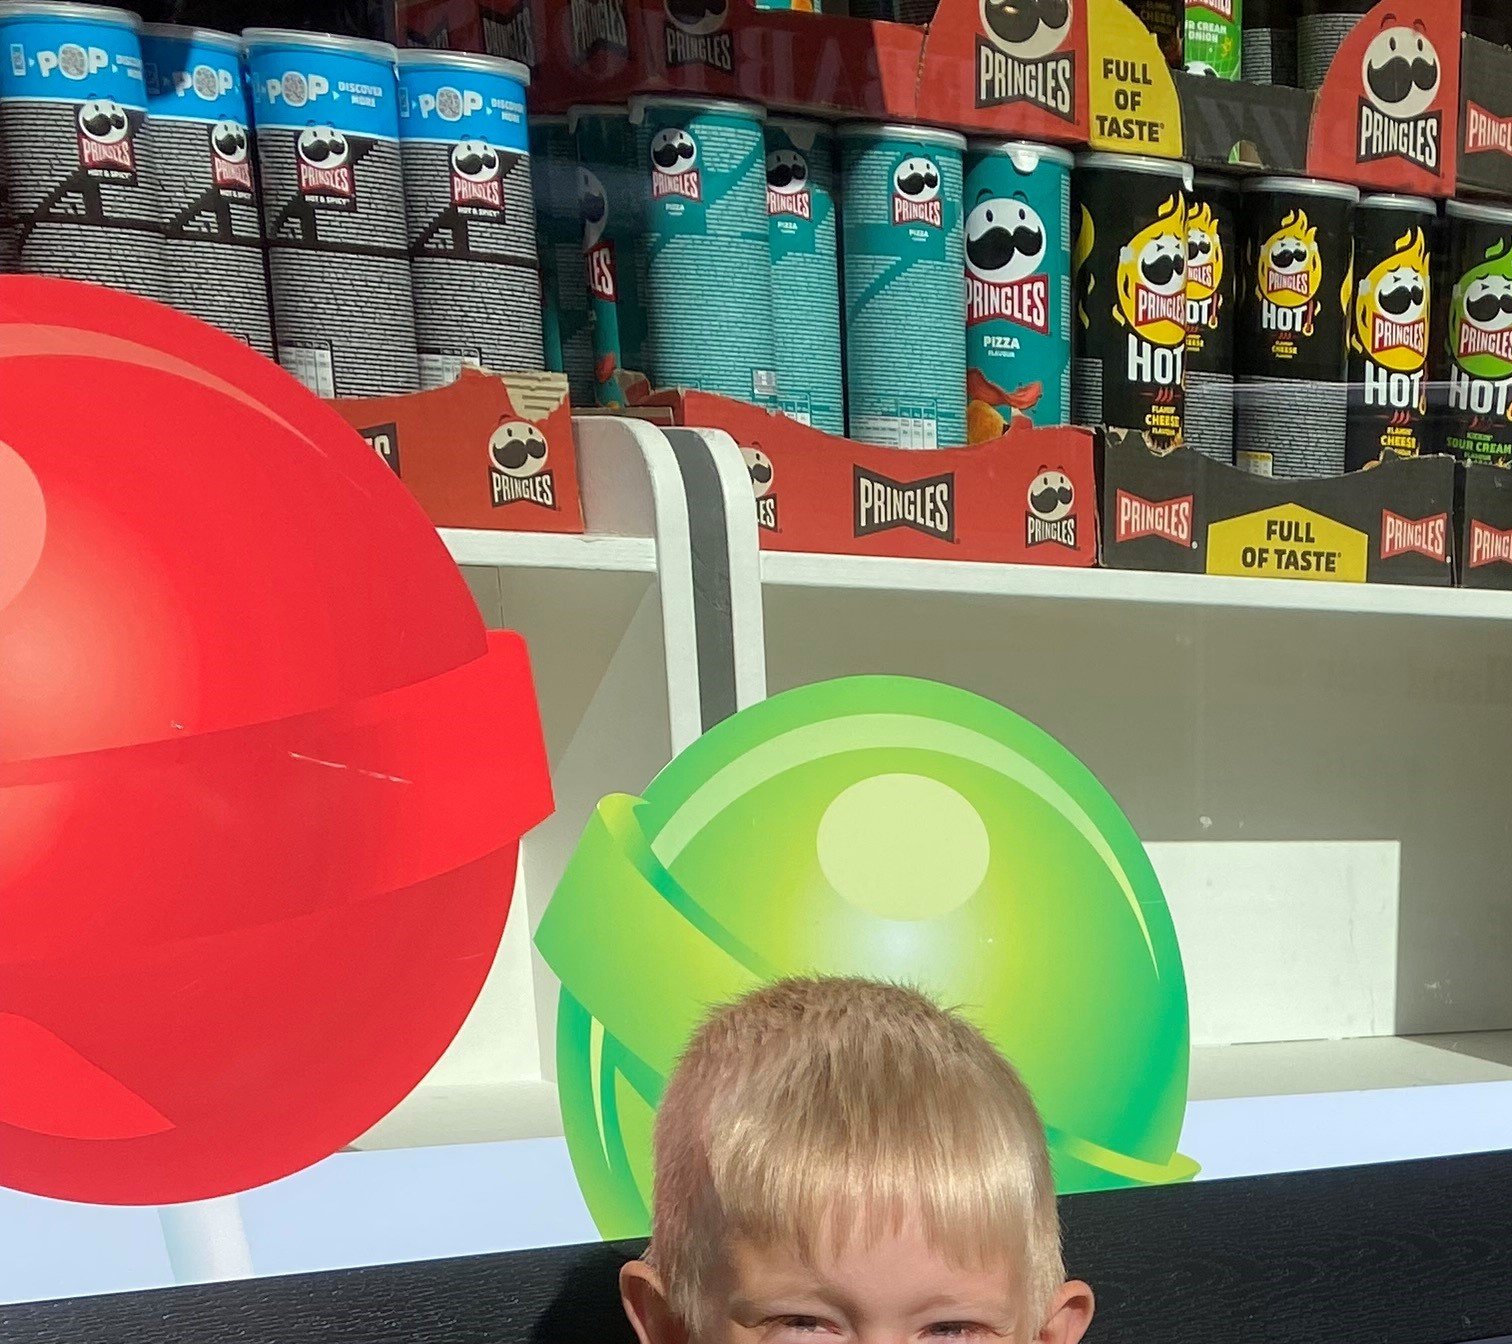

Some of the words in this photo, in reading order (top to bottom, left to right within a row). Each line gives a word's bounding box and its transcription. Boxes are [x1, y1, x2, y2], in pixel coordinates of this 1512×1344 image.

[665, 25, 731, 71] PRINGLES
[980, 45, 1071, 114] PRINGLES
[1102, 58, 1153, 86] FULL
[266, 70, 329, 107] POP
[338, 81, 383, 97] DISCOVER
[1114, 89, 1142, 112] OF
[418, 86, 483, 122] POP
[1095, 114, 1162, 143] TASTE
[1360, 105, 1438, 168] PRINGLES
[652, 170, 698, 201] PRINGLES
[894, 197, 941, 227] PRINGLES
[1187, 264, 1213, 288] NGLES
[1268, 270, 1308, 295] PRINGLES
[1186, 298, 1212, 325] OT
[983, 335, 1020, 350] PIZZA
[1373, 317, 1425, 354] PRINGLES
[1475, 441, 1512, 455] CREAM
[492, 471, 554, 506] PRINGLES
[860, 477, 949, 533] PRINGLES
[1027, 515, 1075, 546] PRINGLES
[1119, 496, 1191, 547] PRINGLES
[1266, 519, 1316, 544] FULL
[1385, 517, 1446, 563] PRINGLES
[1241, 551, 1269, 570] OF
[1273, 549, 1340, 573] TASTE
